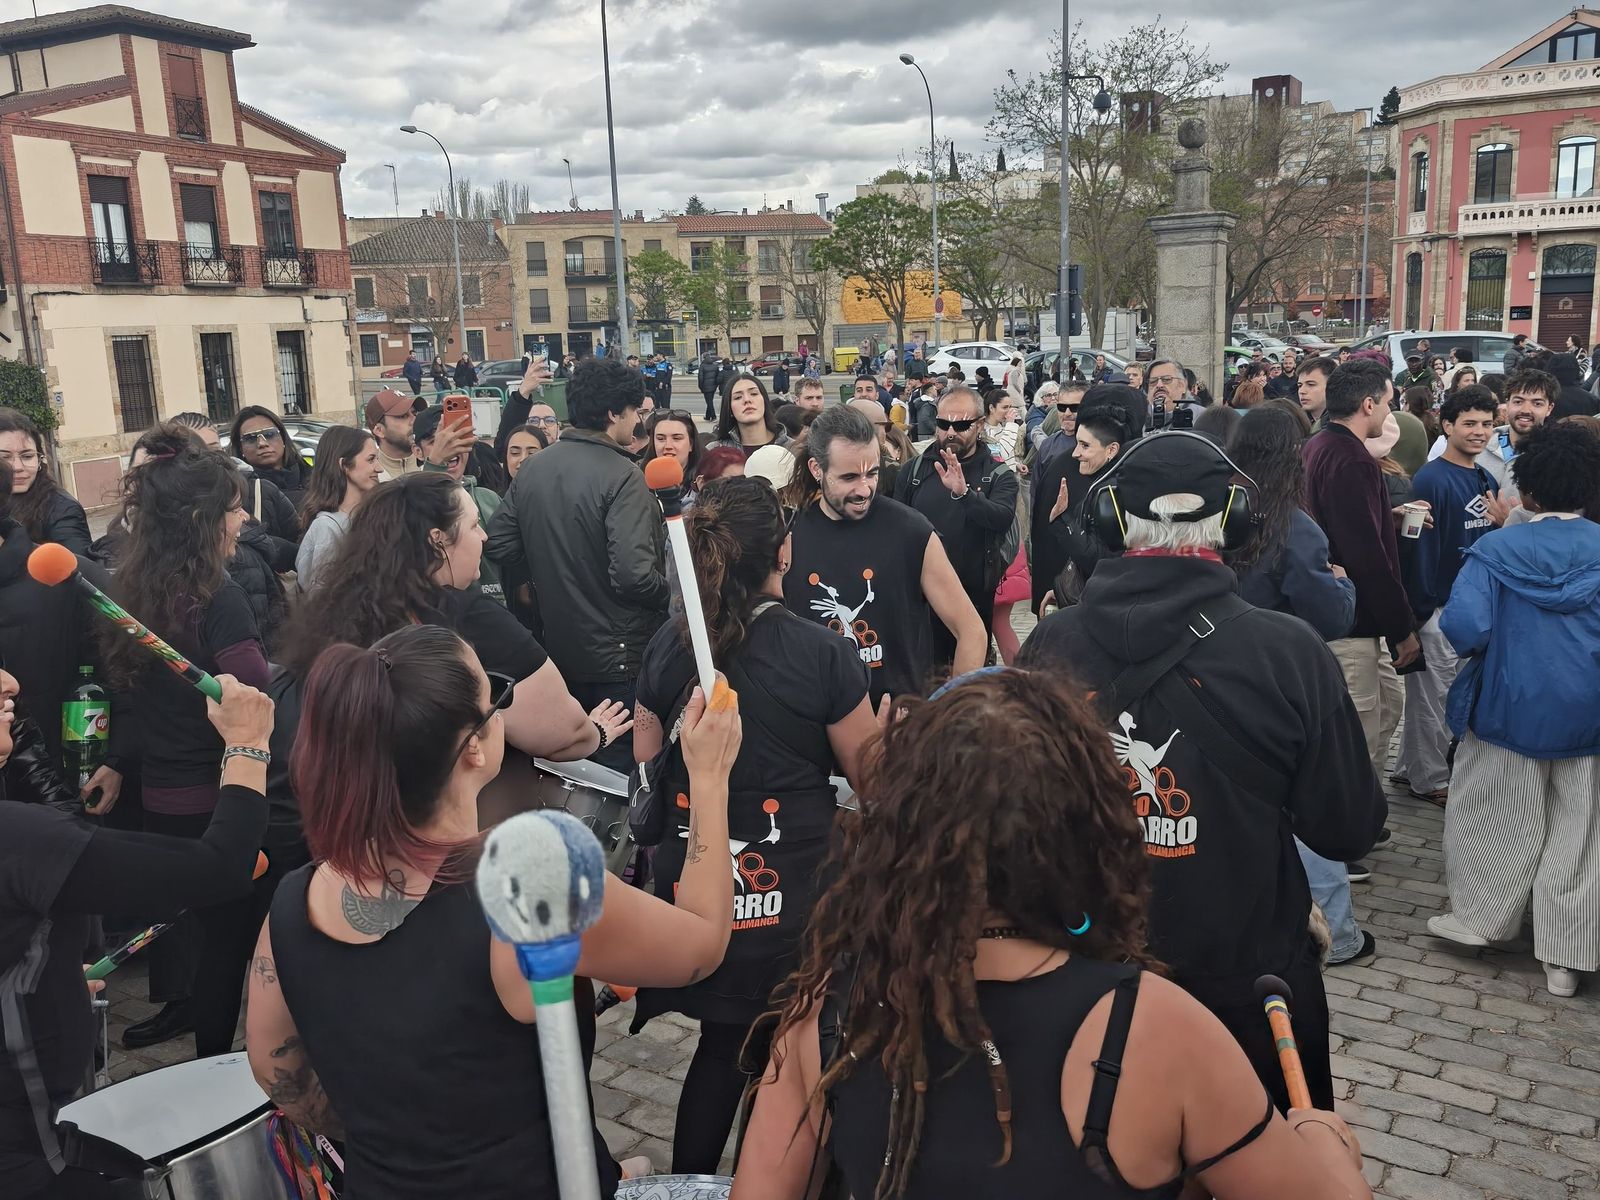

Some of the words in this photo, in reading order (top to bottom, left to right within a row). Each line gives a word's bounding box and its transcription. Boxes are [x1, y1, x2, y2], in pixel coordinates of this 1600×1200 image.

[859, 644, 883, 663] RO
[732, 890, 783, 921] RRO
[731, 915, 780, 931] ALAMANCA
